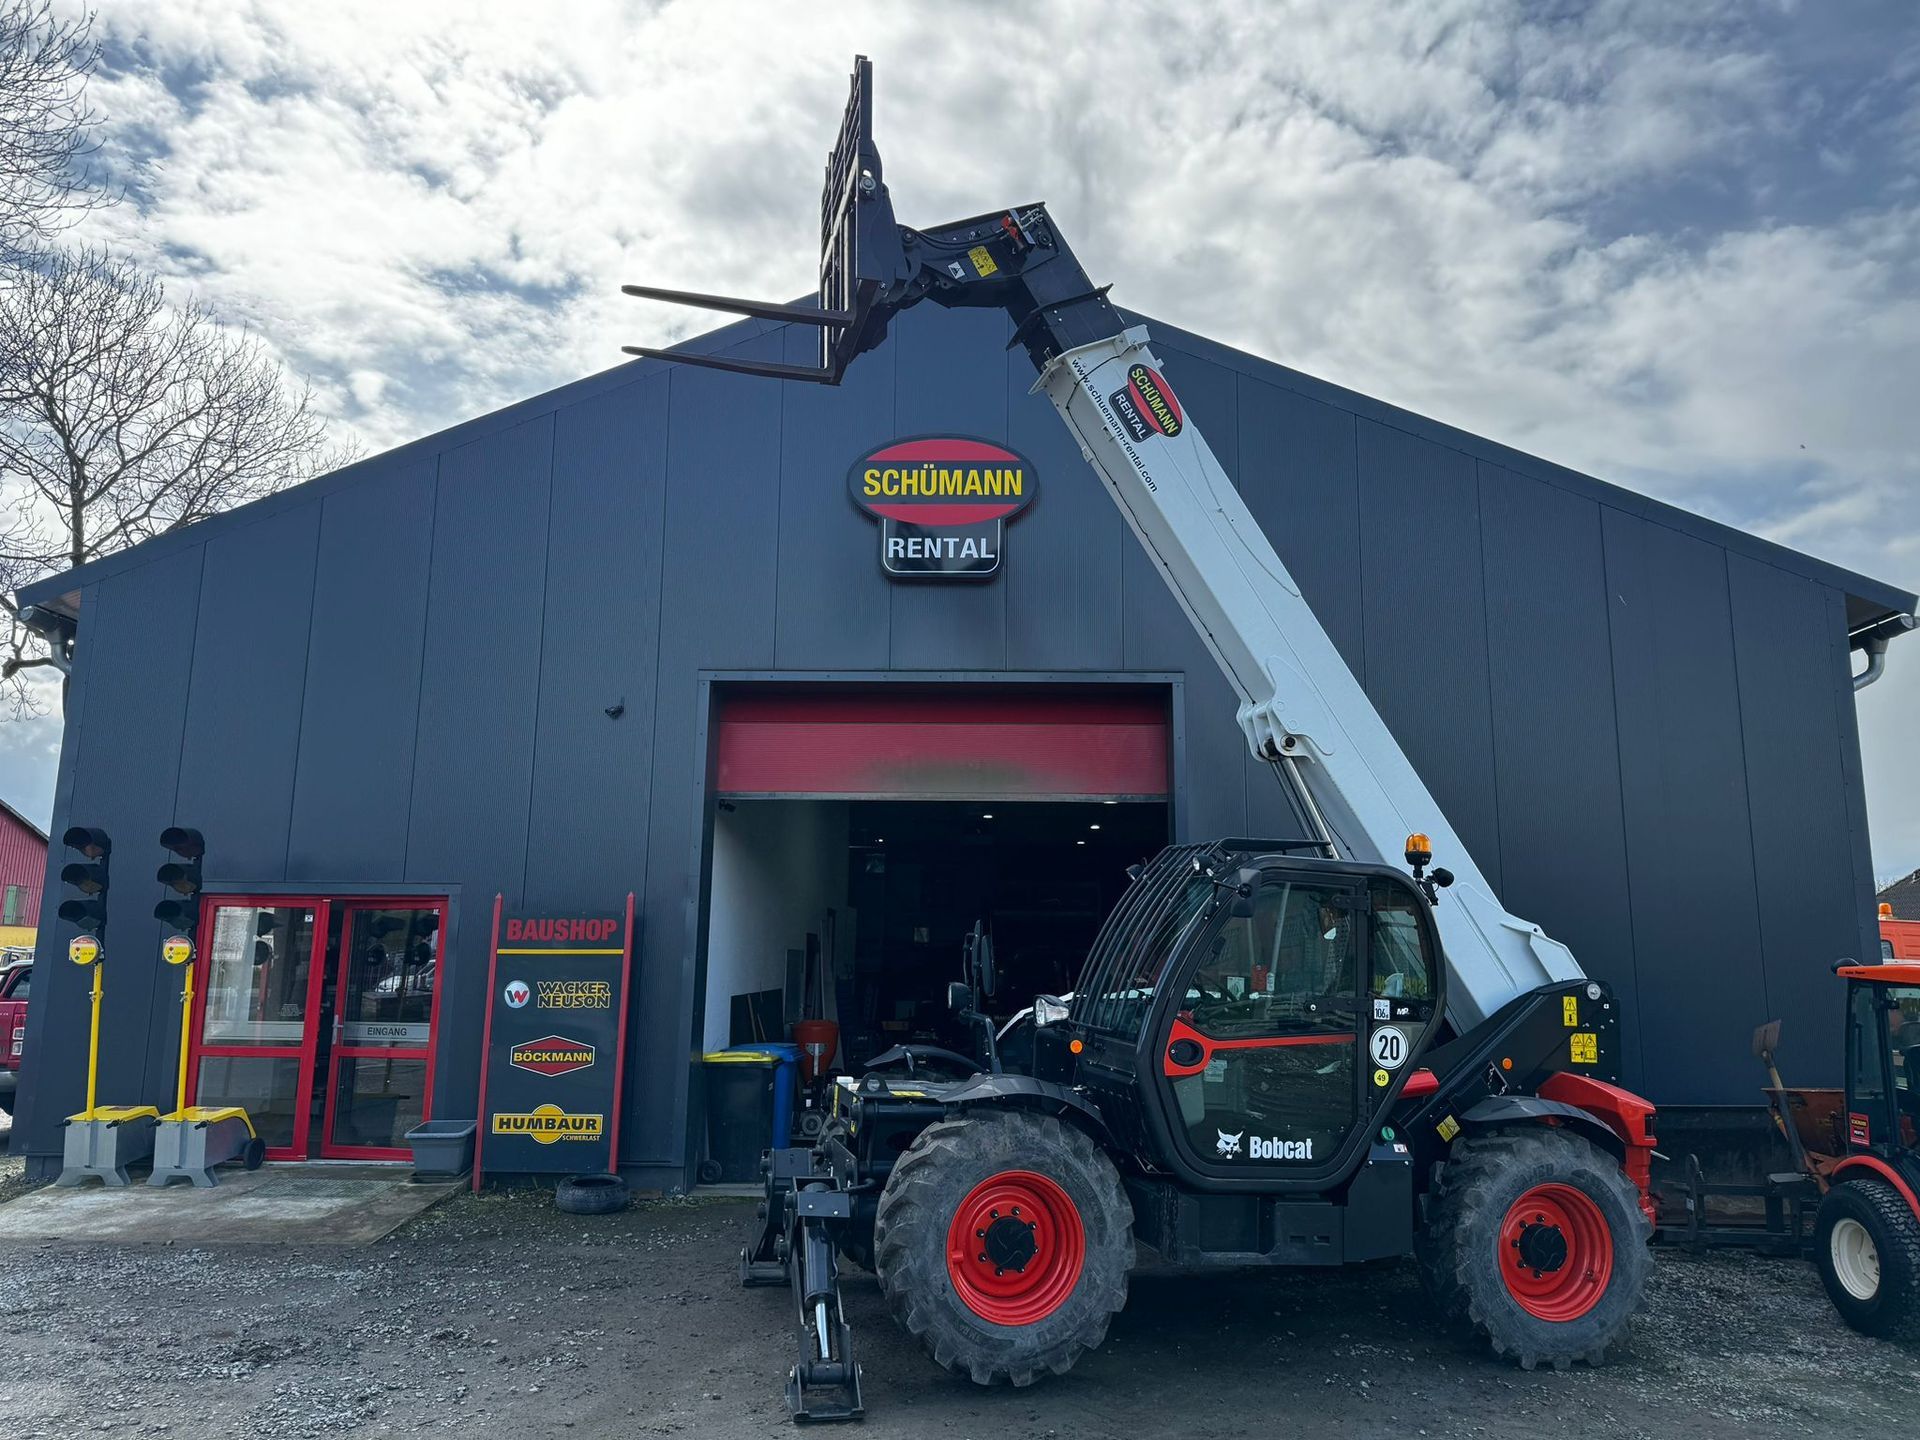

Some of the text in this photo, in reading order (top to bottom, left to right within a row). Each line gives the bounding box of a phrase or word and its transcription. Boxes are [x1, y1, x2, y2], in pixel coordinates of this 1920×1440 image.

[1131, 367, 1178, 434] SCHÜMANN
[1071, 358, 1158, 493] www.schuemann-rental.com
[1115, 393, 1149, 439] RENTAL
[863, 464, 1022, 496] SCHÜMANN
[888, 538, 995, 558] RENTAL
[507, 918, 617, 941] BAUSHOP
[537, 981, 611, 996] WACKER
[537, 994, 611, 1009] NEUSON
[367, 1027, 407, 1036] EINGANG
[513, 1050, 592, 1062] BÖCKMANN
[1379, 1035, 1399, 1060] 20
[498, 1117, 597, 1131] HUMBAUR
[1249, 1136, 1313, 1160] Bobcat
